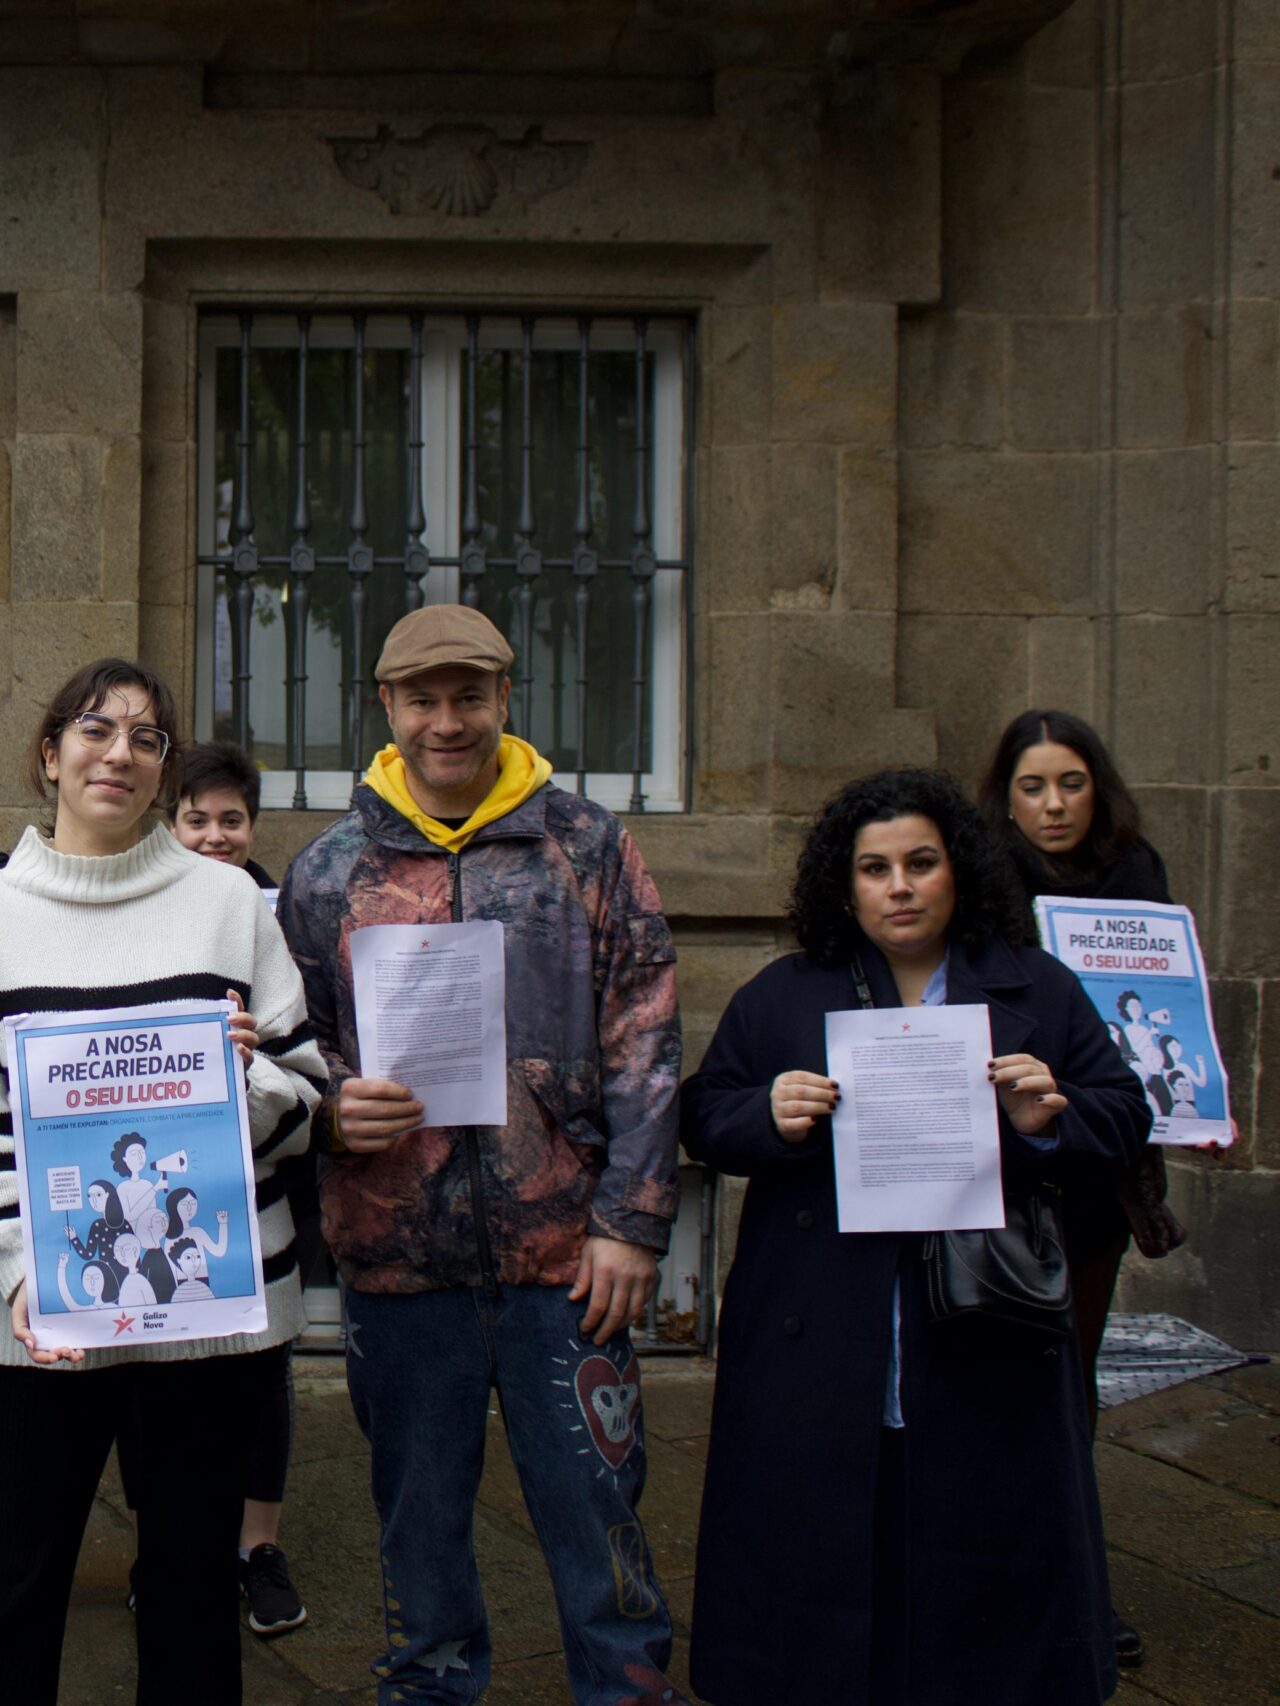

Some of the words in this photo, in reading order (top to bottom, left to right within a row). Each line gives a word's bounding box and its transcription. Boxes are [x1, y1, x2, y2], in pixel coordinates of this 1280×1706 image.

[1093, 919, 1104, 933] A
[1107, 920, 1148, 935] NOSA
[1069, 934, 1177, 953] PRECARIEDADE
[1083, 954, 1093, 967] O
[1096, 955, 1122, 969] SEU
[1125, 956, 1169, 971] LUCRO
[85, 1037, 100, 1057] A
[105, 1033, 163, 1055] NOSA
[47, 1052, 205, 1084] PRECARIEDADE
[65, 1091, 81, 1109] O
[84, 1086, 126, 1107] SEU
[127, 1080, 192, 1105] LUCRO
[142, 1312, 168, 1321] Galiza
[143, 1321, 164, 1329] Nova
